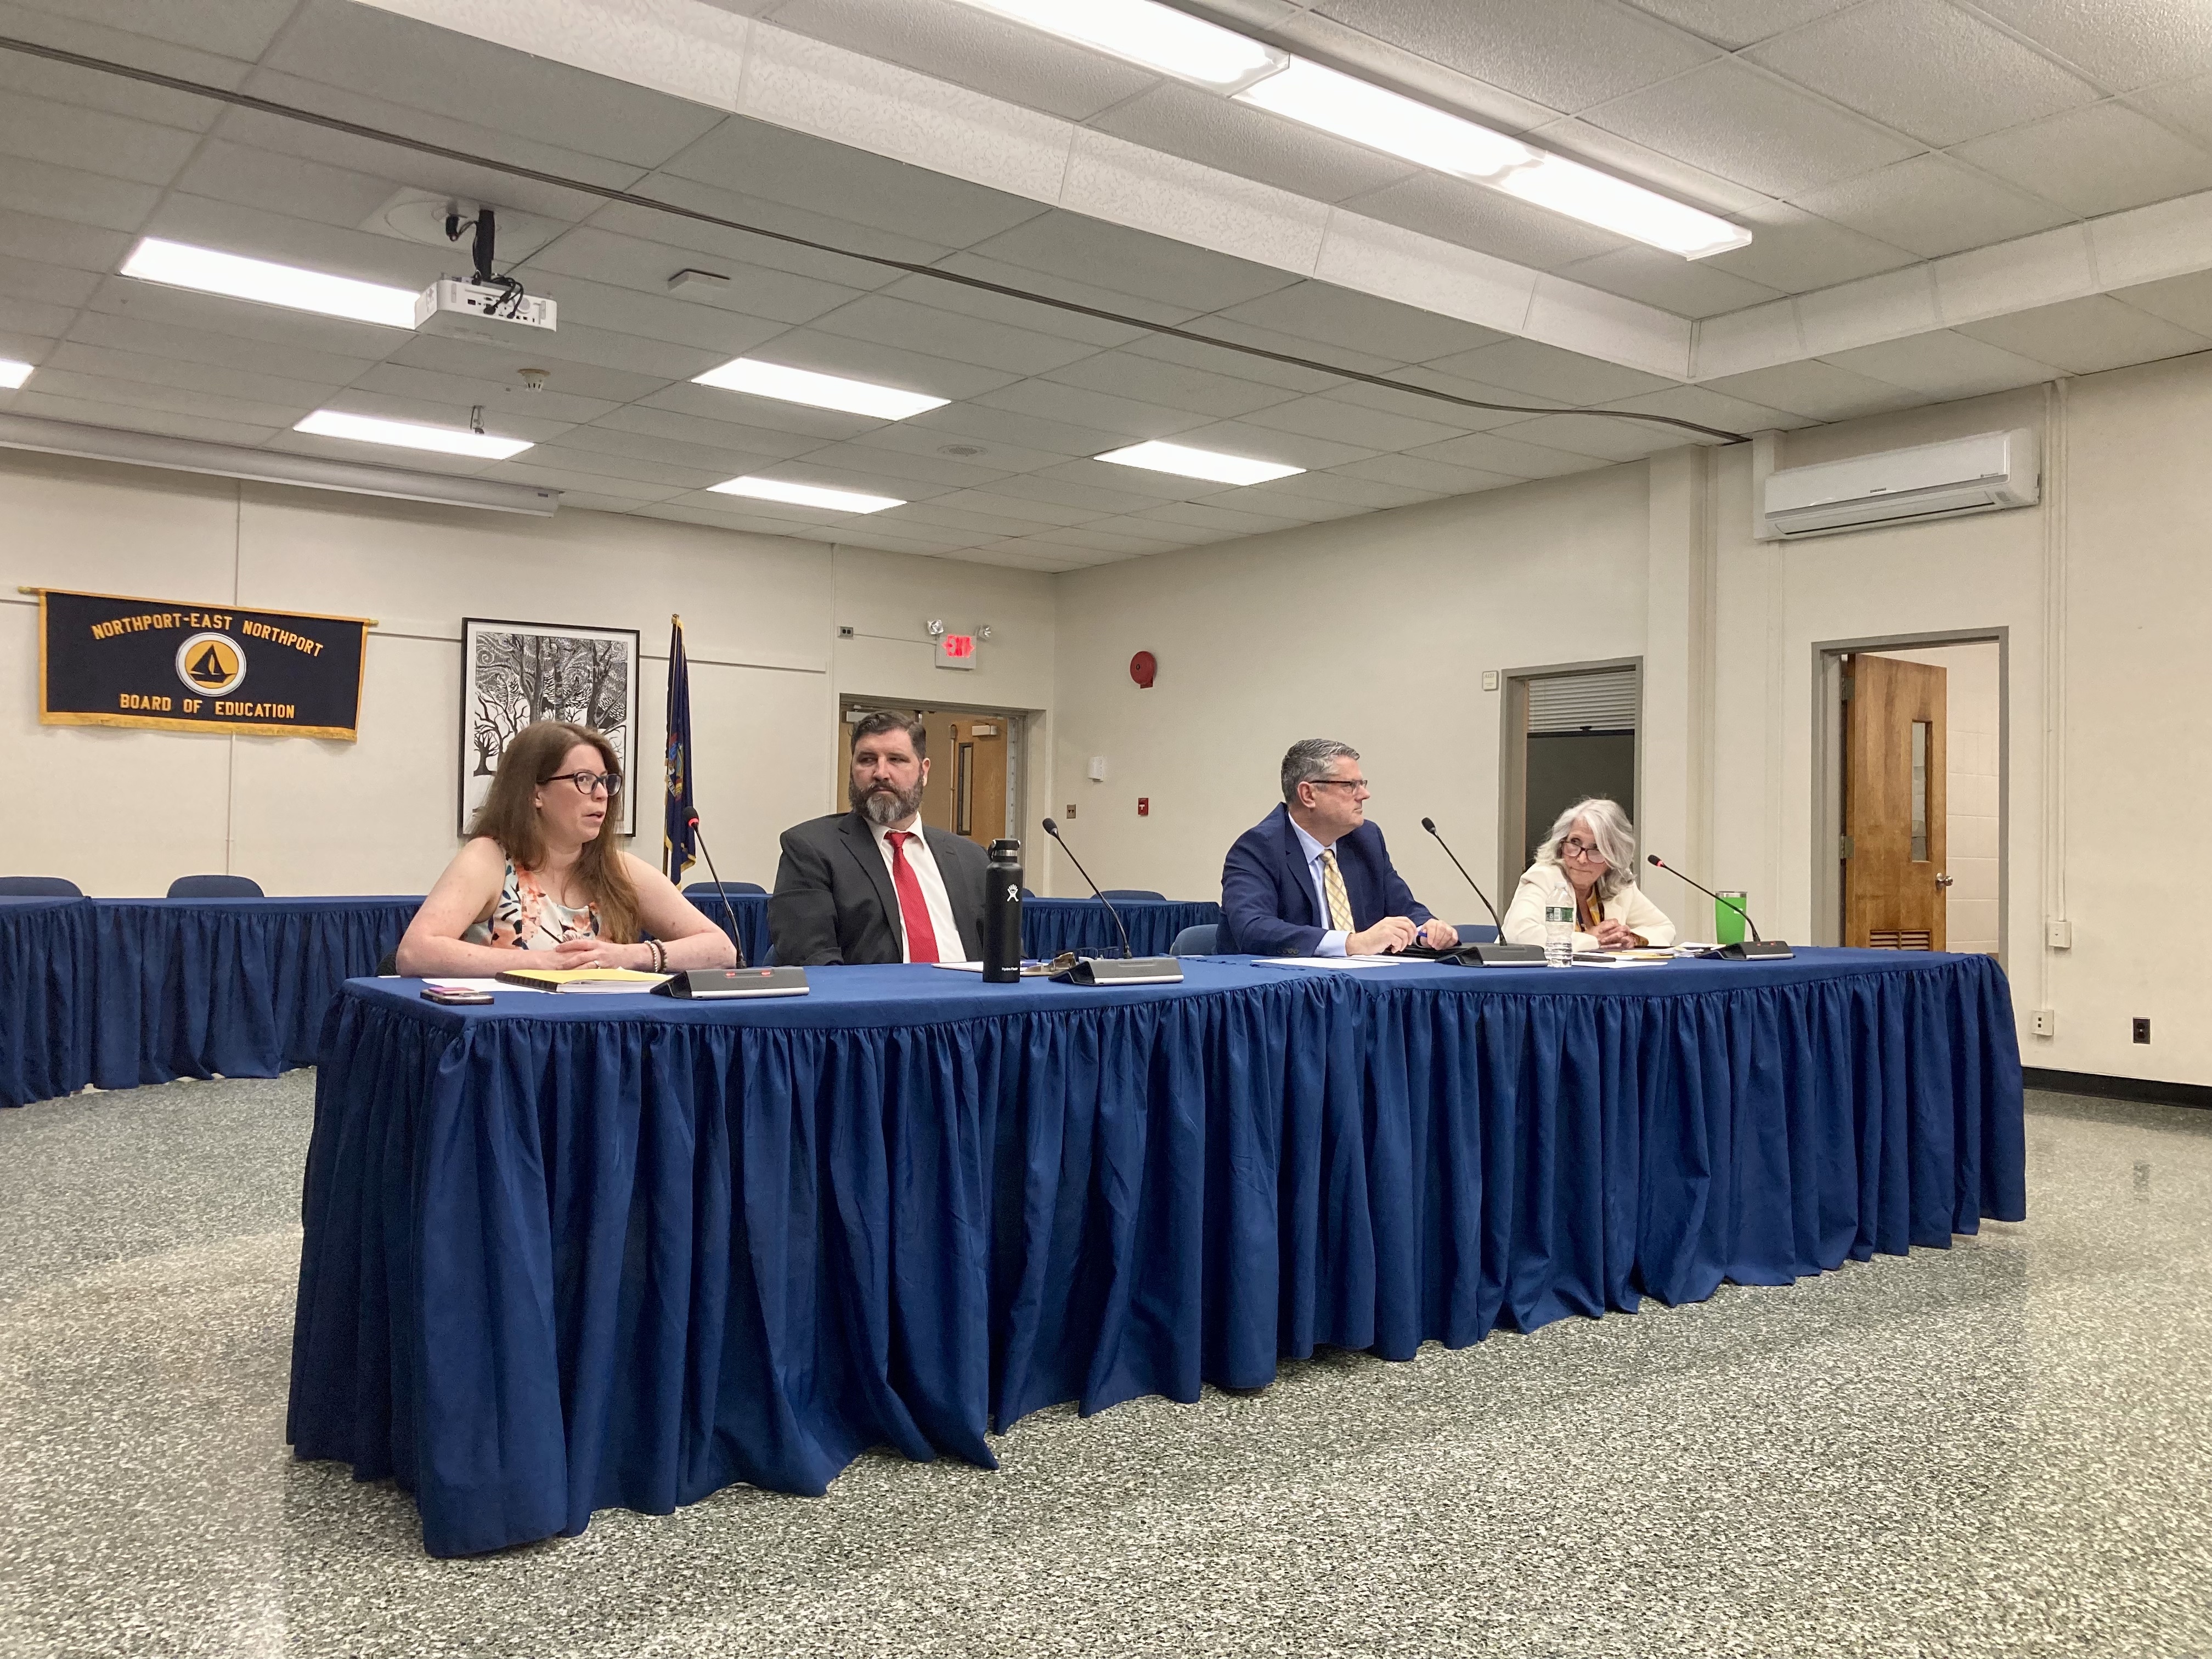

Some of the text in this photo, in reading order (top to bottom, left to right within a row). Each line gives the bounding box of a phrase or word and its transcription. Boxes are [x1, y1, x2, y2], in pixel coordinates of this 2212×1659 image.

[91, 613, 324, 657] NORTHPORT-EAST NORTHPORT
[947, 634, 972, 658] EXIT
[120, 693, 295, 719] BOARD OF EDUCATION
